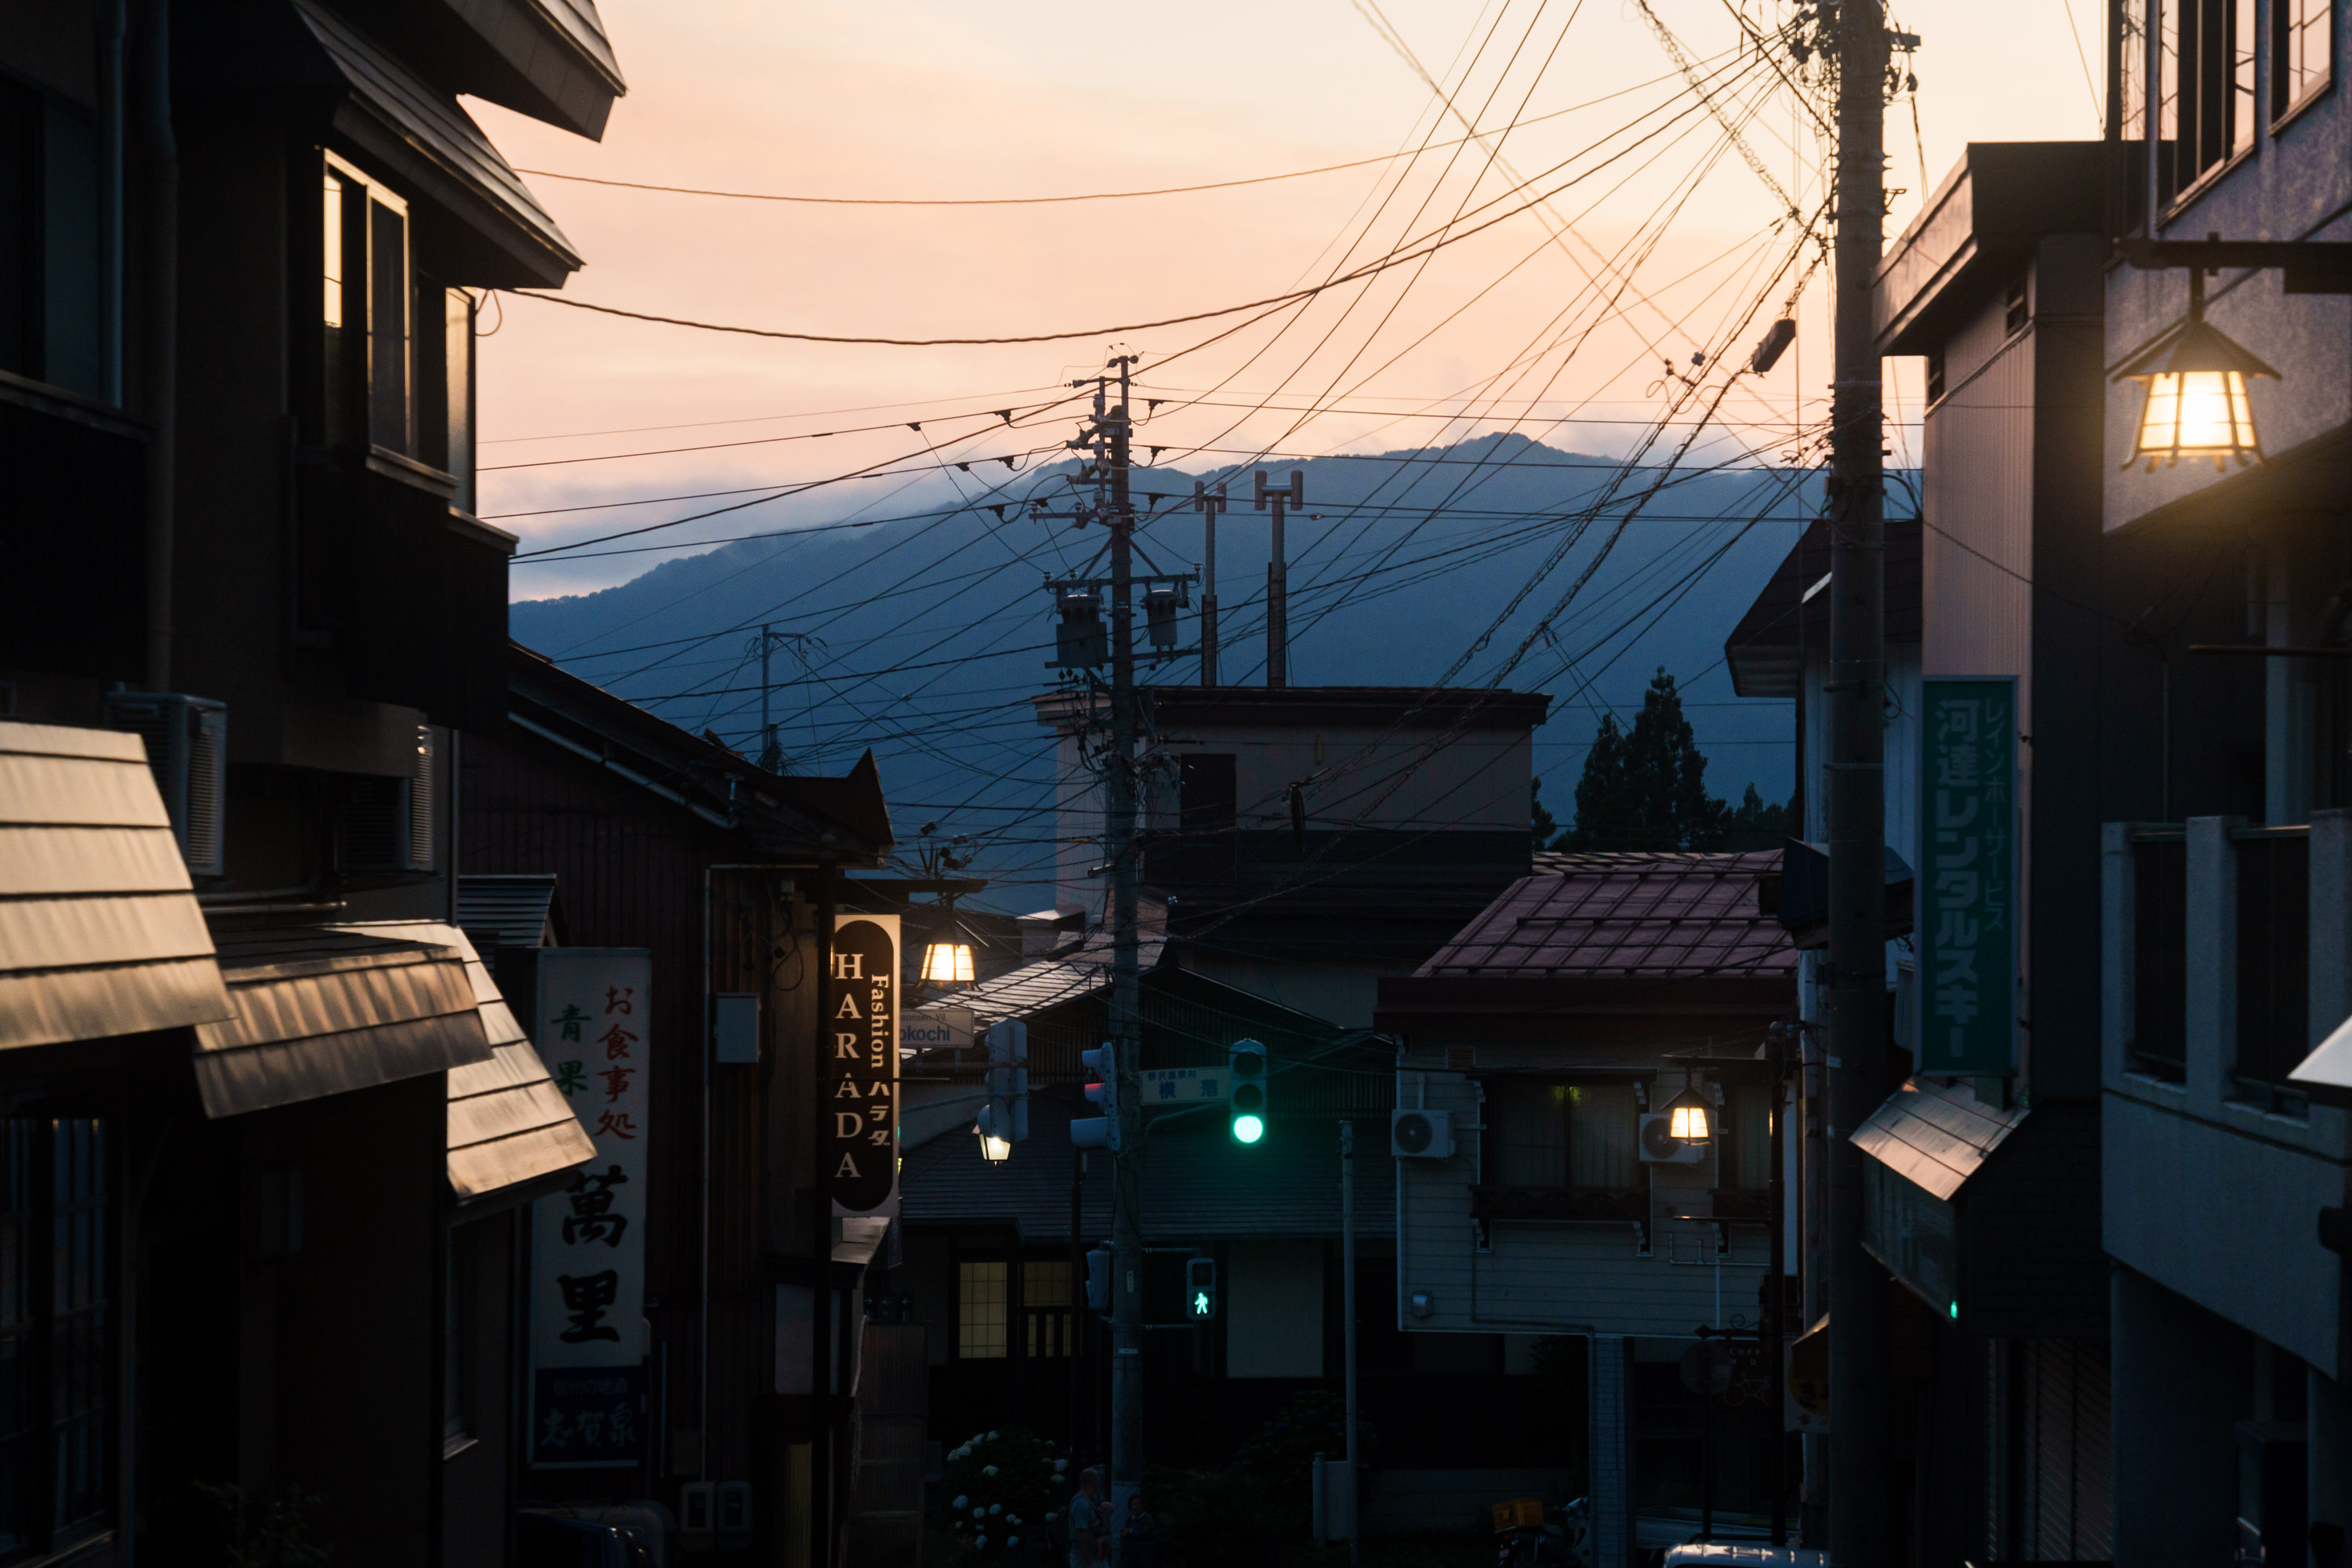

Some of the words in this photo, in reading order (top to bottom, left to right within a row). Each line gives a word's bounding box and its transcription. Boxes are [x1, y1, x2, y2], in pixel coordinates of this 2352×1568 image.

[552, 1004, 591, 1097] 青果
[593, 985, 639, 1140] お食事処
[835, 953, 864, 1178] HARADA
[871, 974, 890, 1069] Fashion
[900, 1025, 950, 1042] okochi
[868, 1081, 891, 1146] ハラダ
[557, 1164, 628, 1344] 萬里
